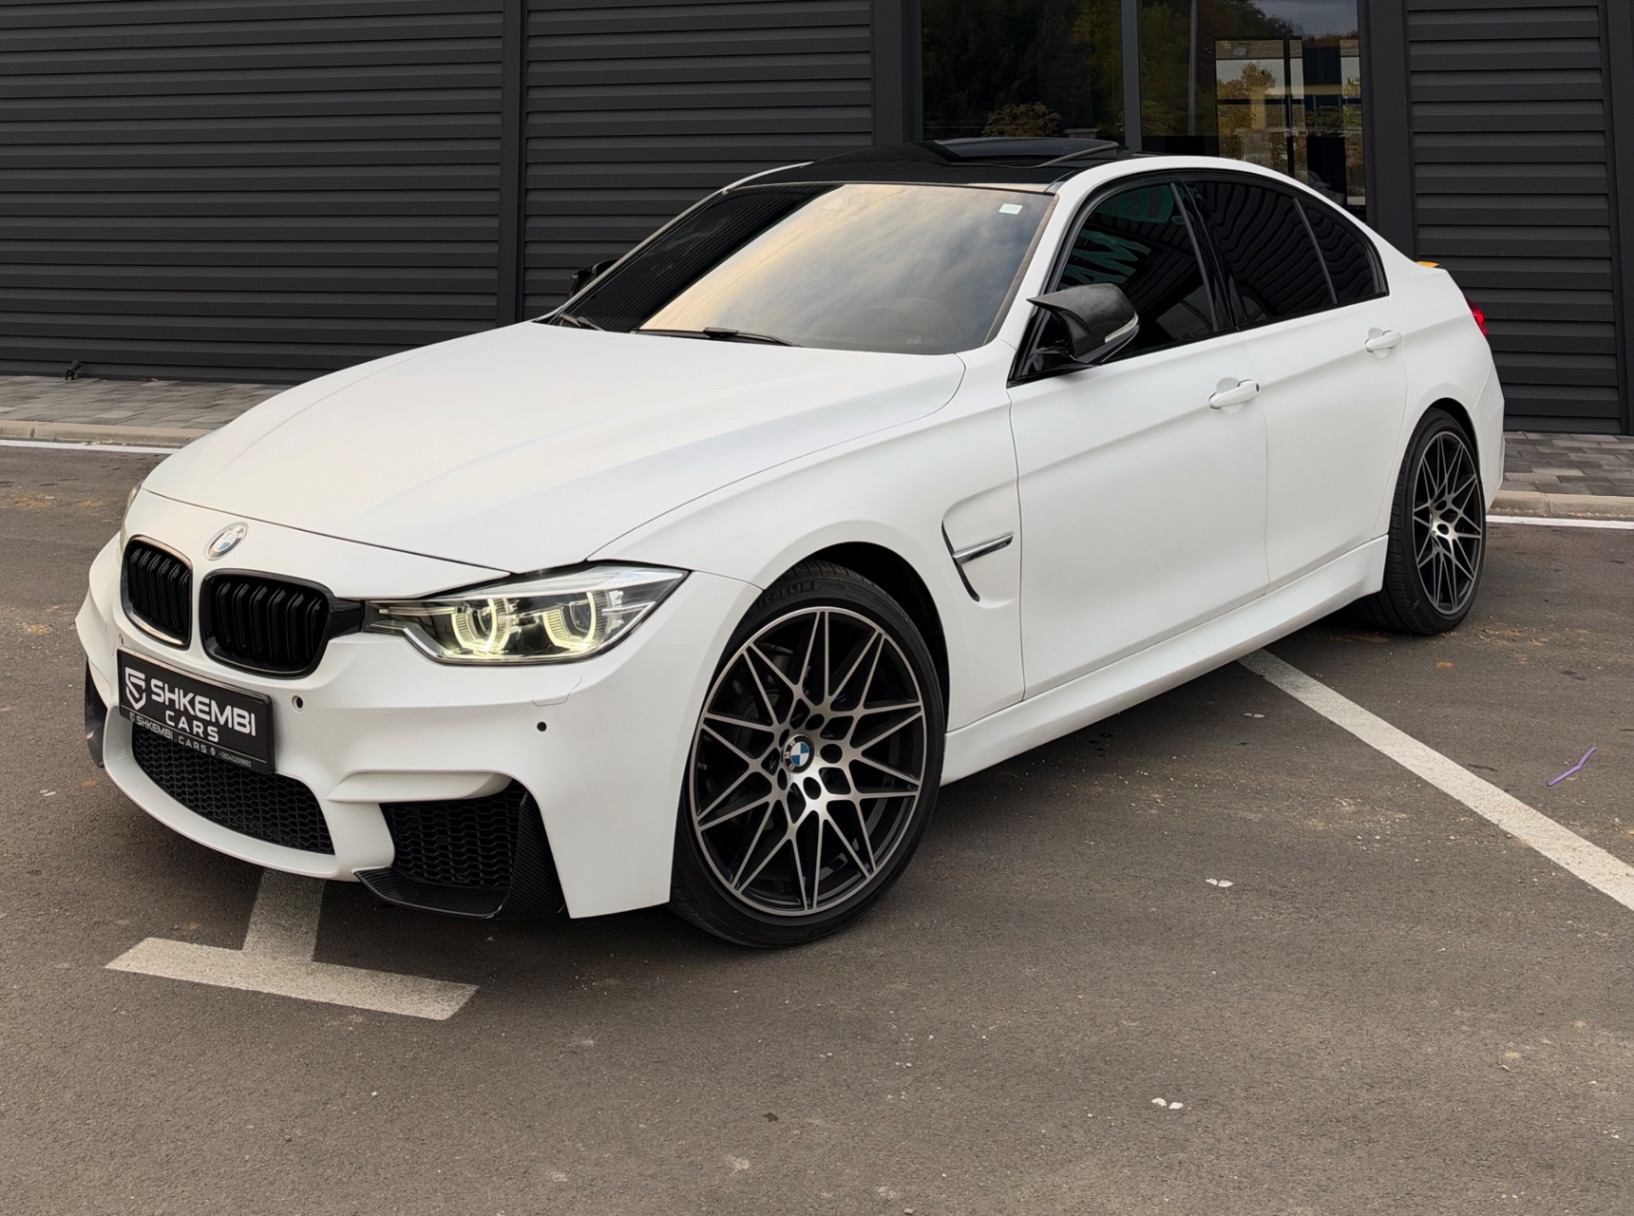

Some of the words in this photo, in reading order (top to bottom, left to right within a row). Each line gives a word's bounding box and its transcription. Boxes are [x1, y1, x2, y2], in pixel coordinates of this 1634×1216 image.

[150, 678, 256, 736] SHKEMBI
[165, 710, 219, 742] CARS
[136, 715, 173, 740] SHKEMBI
[178, 737, 207, 754] CARS
